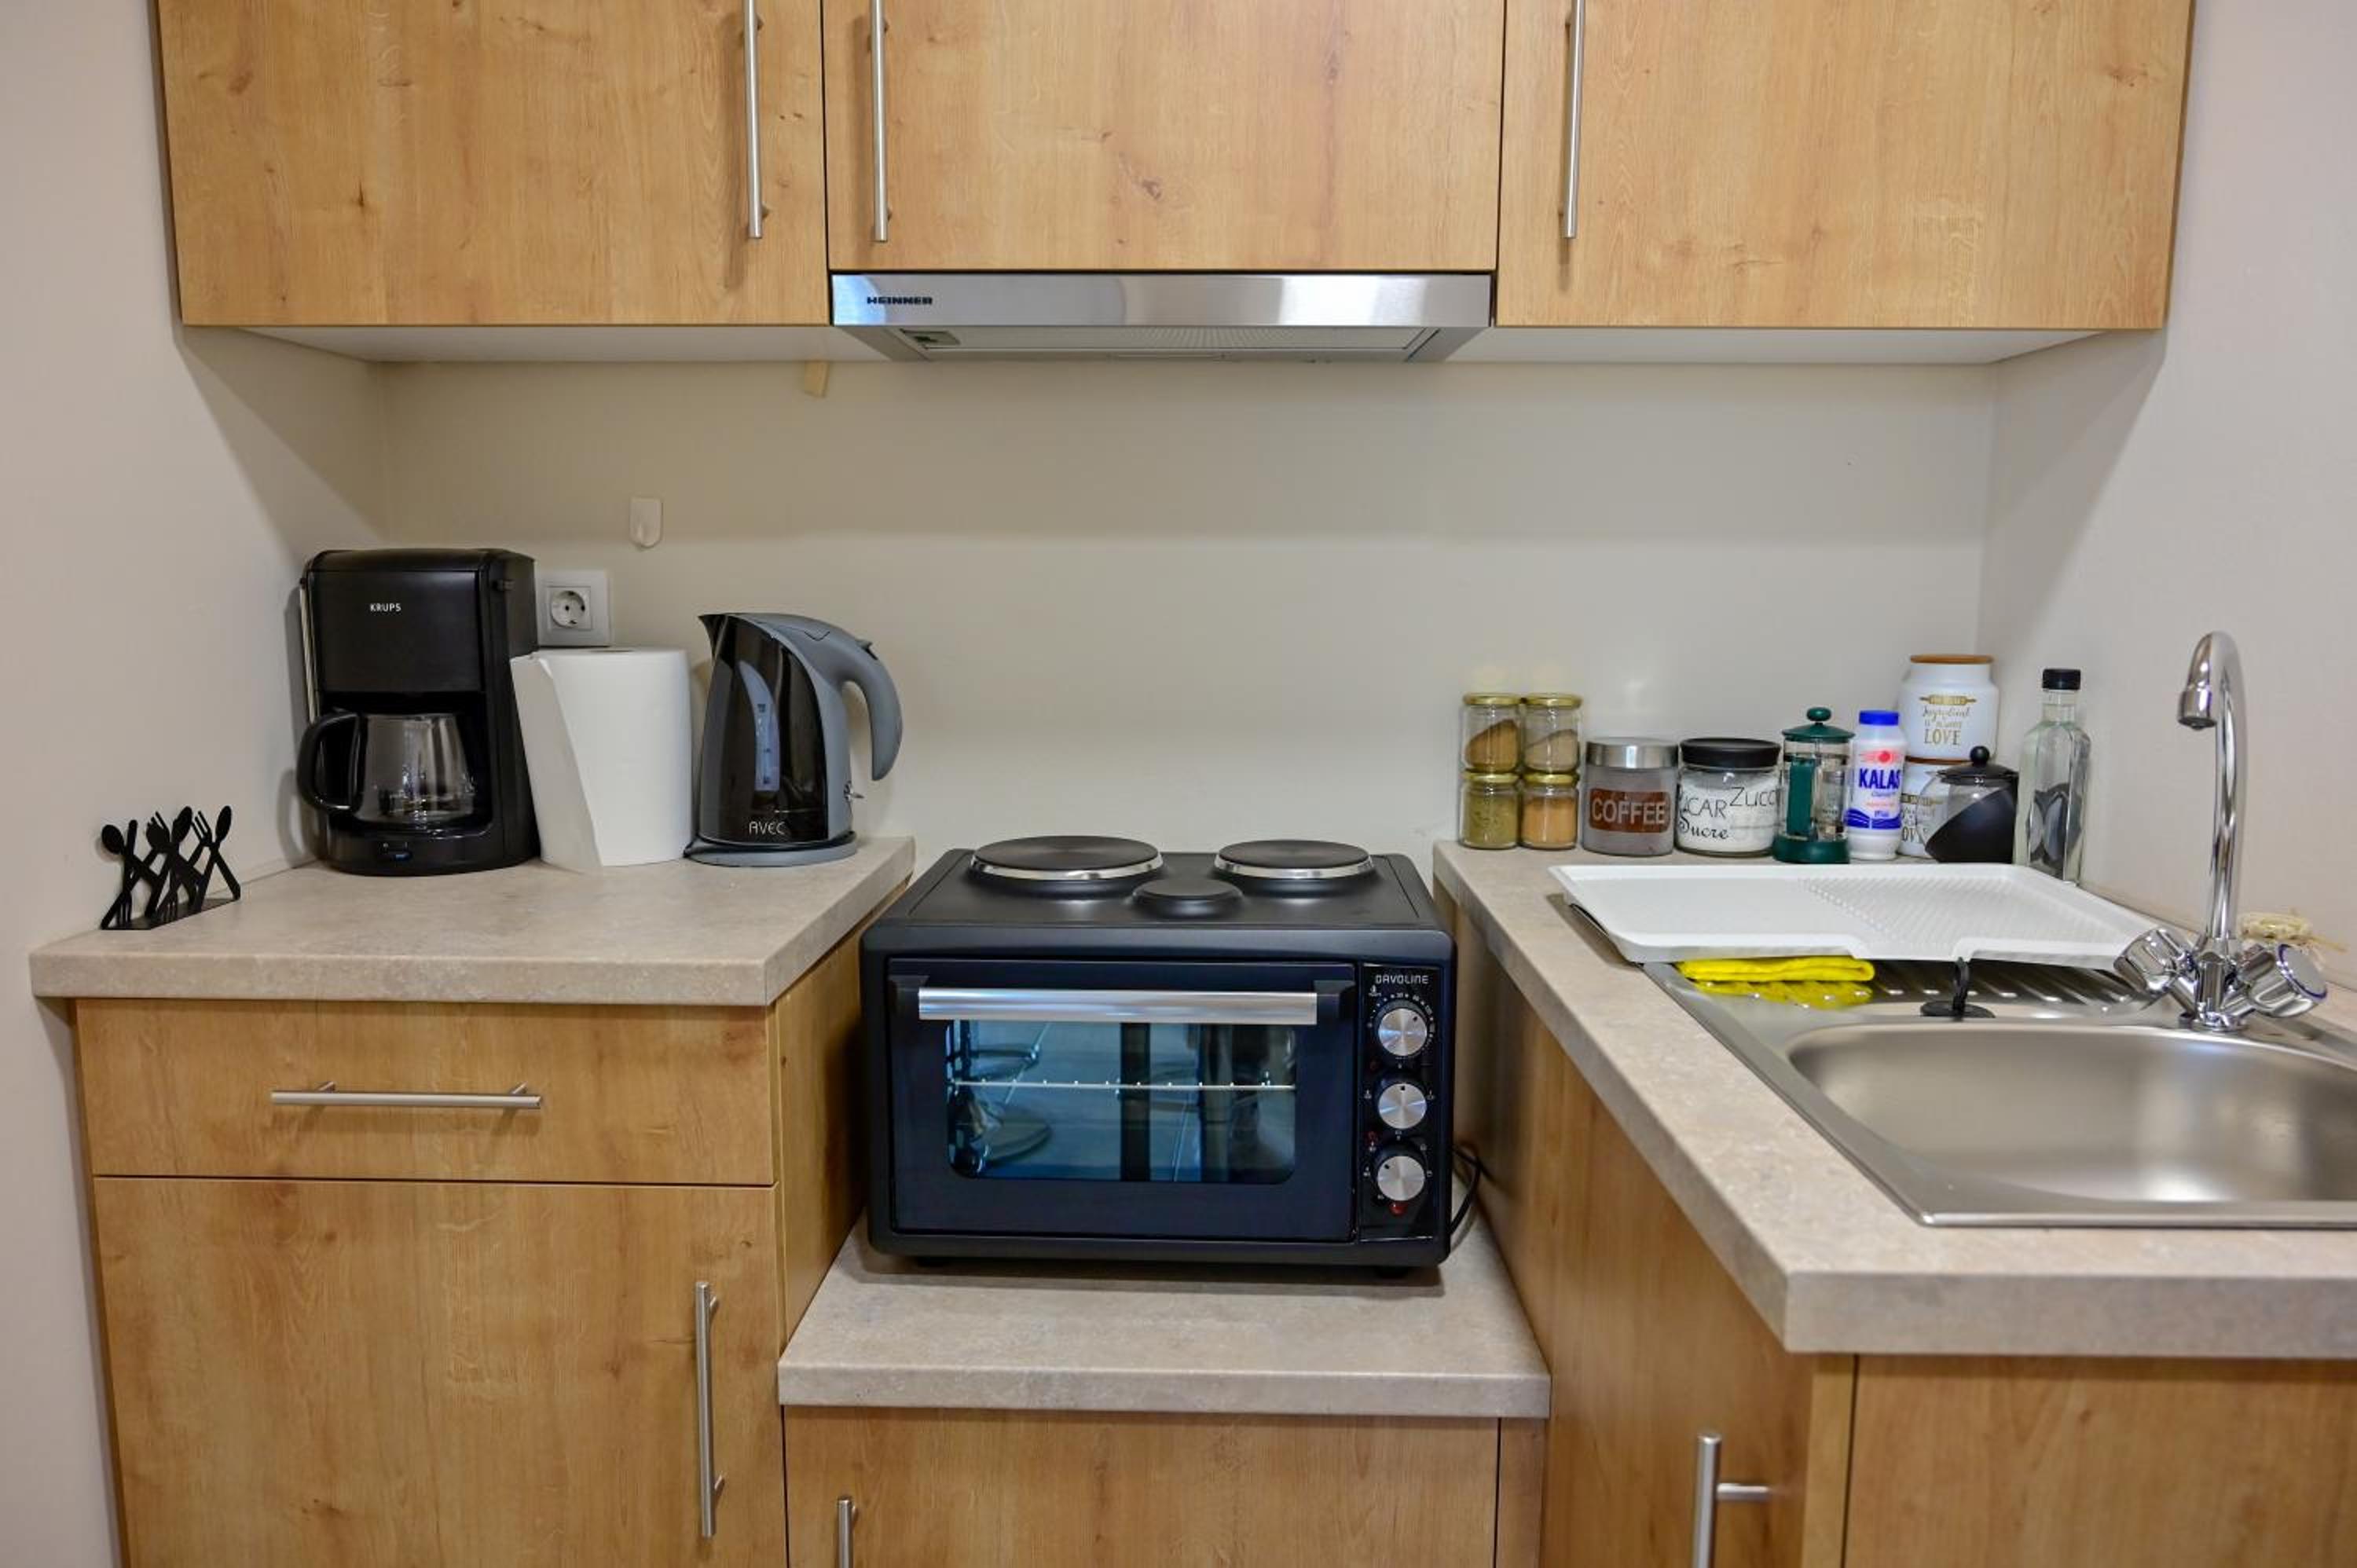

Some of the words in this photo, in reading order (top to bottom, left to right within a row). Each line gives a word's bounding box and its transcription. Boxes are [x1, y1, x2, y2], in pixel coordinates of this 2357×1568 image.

[867, 296, 933, 305] HEINNER
[370, 603, 401, 612] KRUPS
[1923, 729, 1962, 746] LOVE
[1591, 797, 1666, 824] COFFEE
